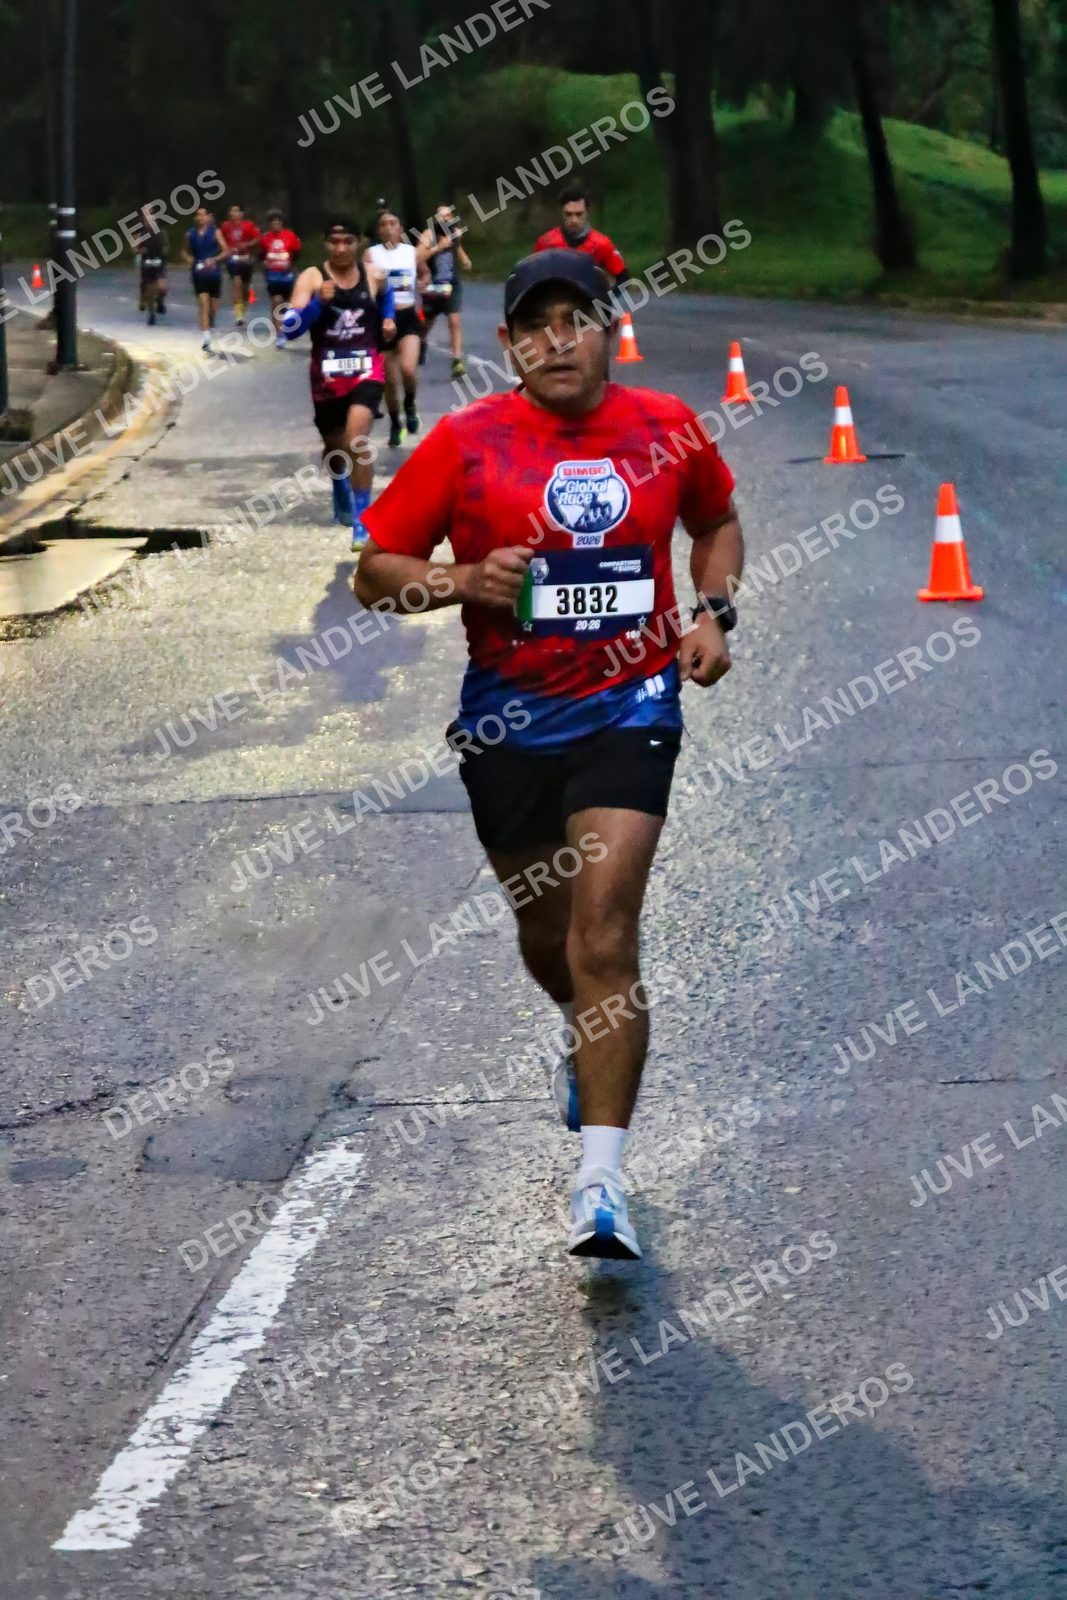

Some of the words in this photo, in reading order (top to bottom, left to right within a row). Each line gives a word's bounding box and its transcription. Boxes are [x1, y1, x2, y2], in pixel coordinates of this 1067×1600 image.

[566, 480, 608, 493] Global
[559, 492, 593, 505] Race
[556, 584, 619, 616] 3832
